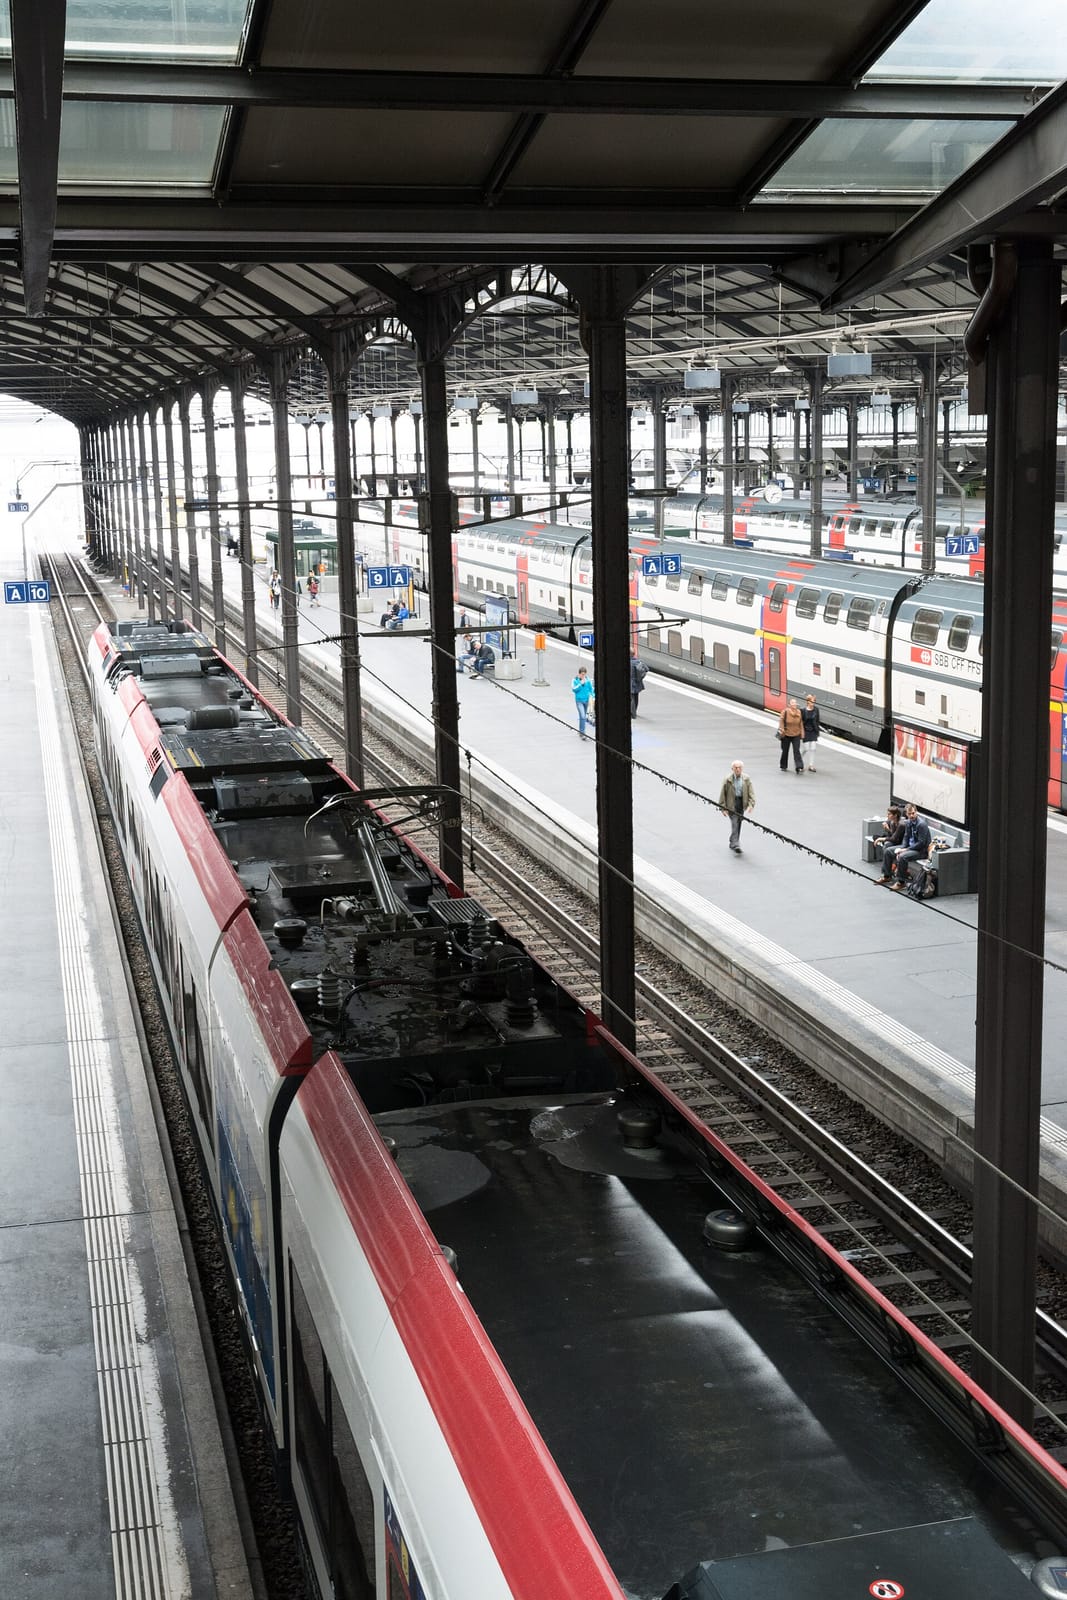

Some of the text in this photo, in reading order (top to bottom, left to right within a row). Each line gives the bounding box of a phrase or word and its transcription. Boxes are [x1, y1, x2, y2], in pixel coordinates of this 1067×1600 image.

[951, 541, 976, 553] 7 A
[648, 560, 676, 573] A 8
[373, 573, 405, 585] 9 A
[11, 587, 47, 601] A 10
[934, 653, 981, 675] SBB CFF FFS
